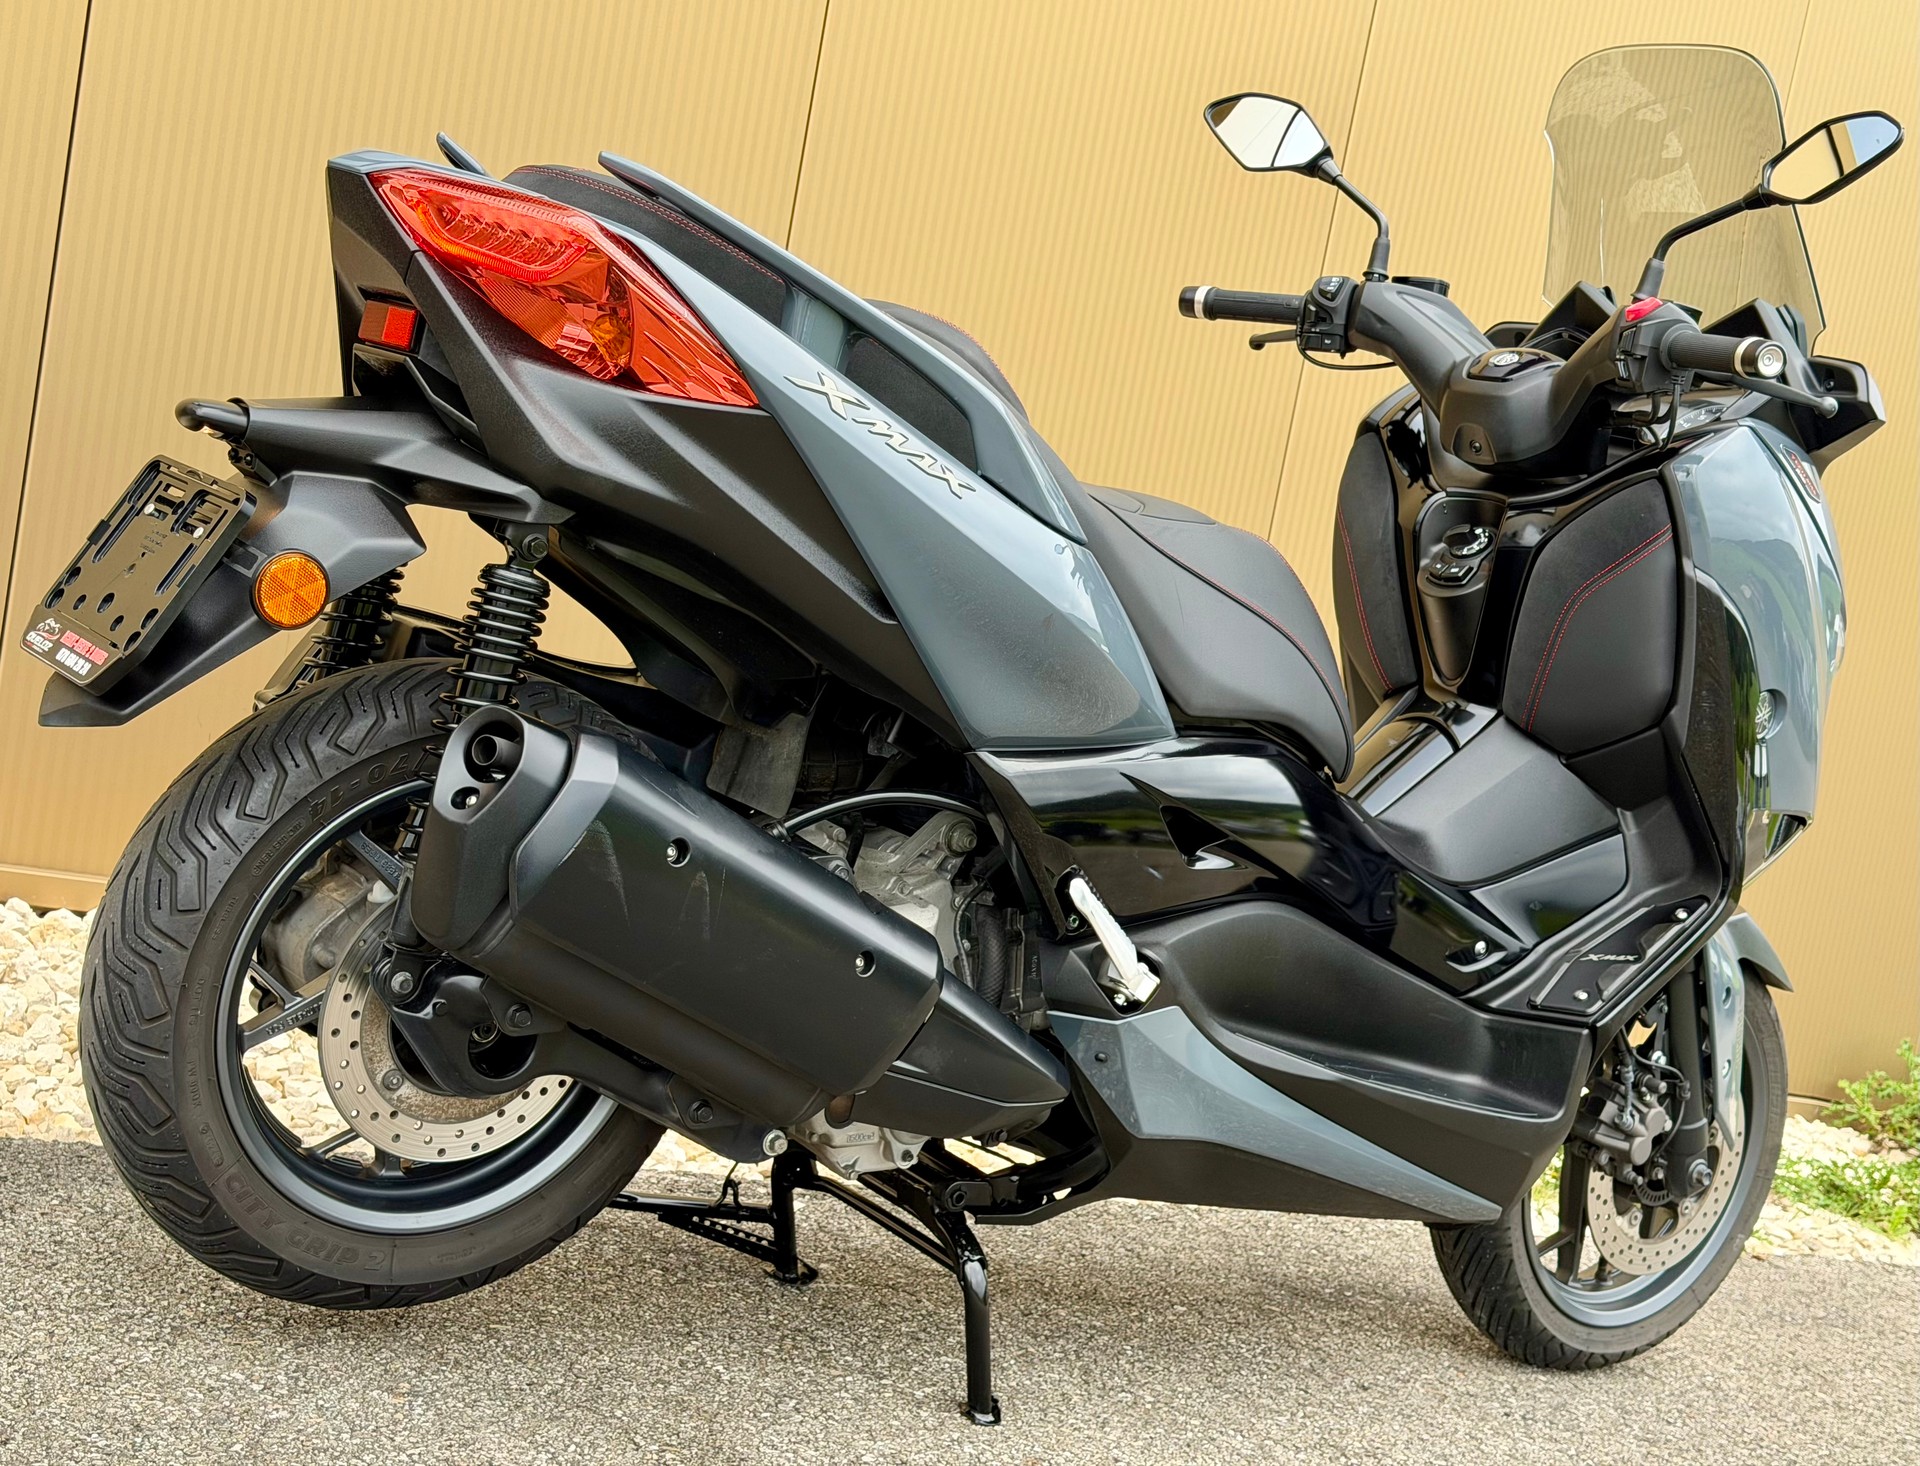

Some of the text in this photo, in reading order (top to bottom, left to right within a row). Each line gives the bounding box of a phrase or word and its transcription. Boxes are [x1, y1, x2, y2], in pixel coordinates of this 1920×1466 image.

[226, 1174, 387, 1271] CITY GRIP 2
